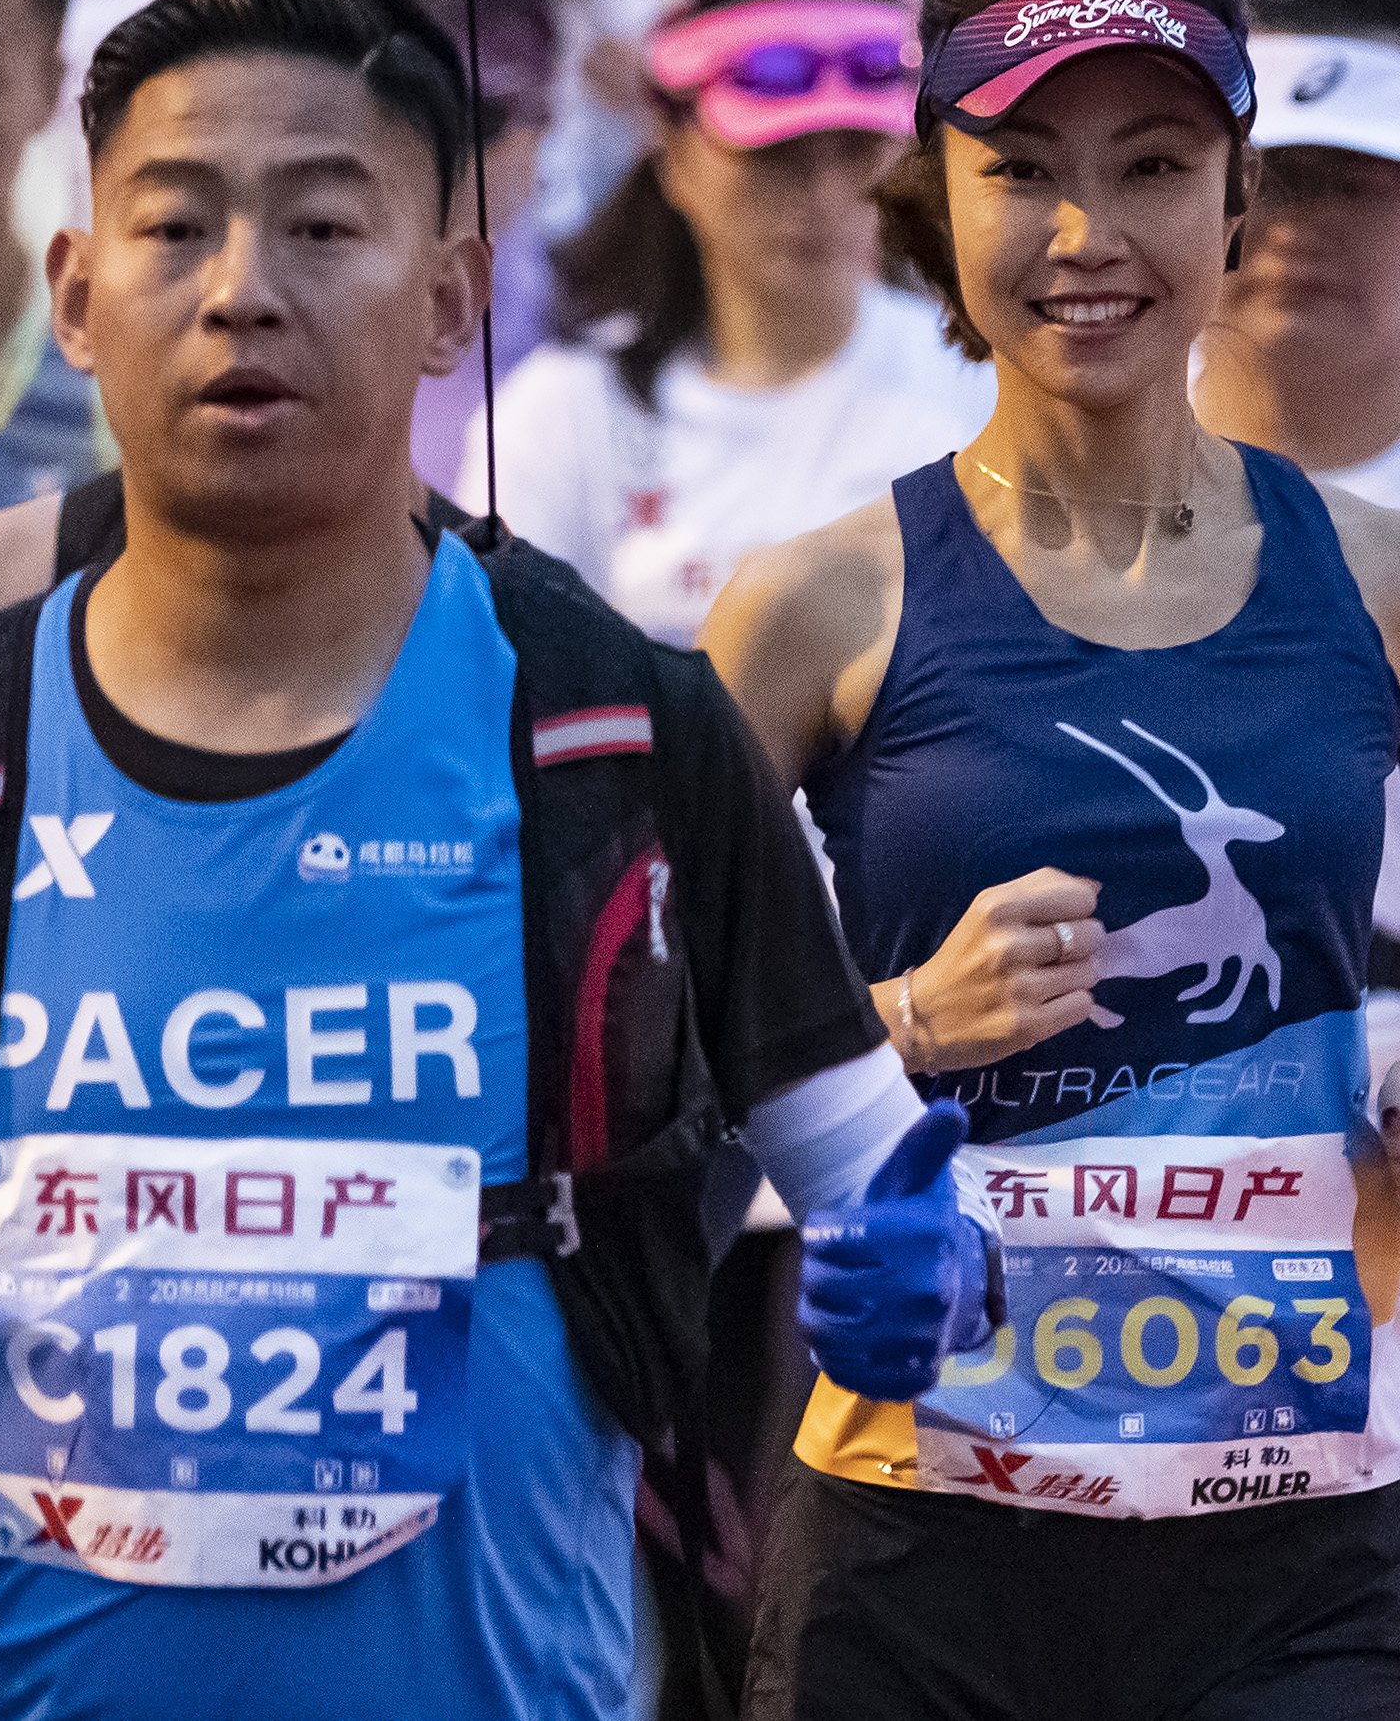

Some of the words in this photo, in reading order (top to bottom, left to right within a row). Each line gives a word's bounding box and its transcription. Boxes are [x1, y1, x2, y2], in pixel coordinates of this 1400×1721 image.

[1030, 31, 1081, 47] KONA
[954, 1061, 1305, 1108] ULTRAGEAR
[34, 1169, 398, 1239] 东风日产
[984, 1164, 1304, 1222] 东风日产
[6, 1324, 418, 1435] C1824
[1223, 1446, 1291, 1470] 科勒
[1191, 1470, 1311, 1507] KOHLER
